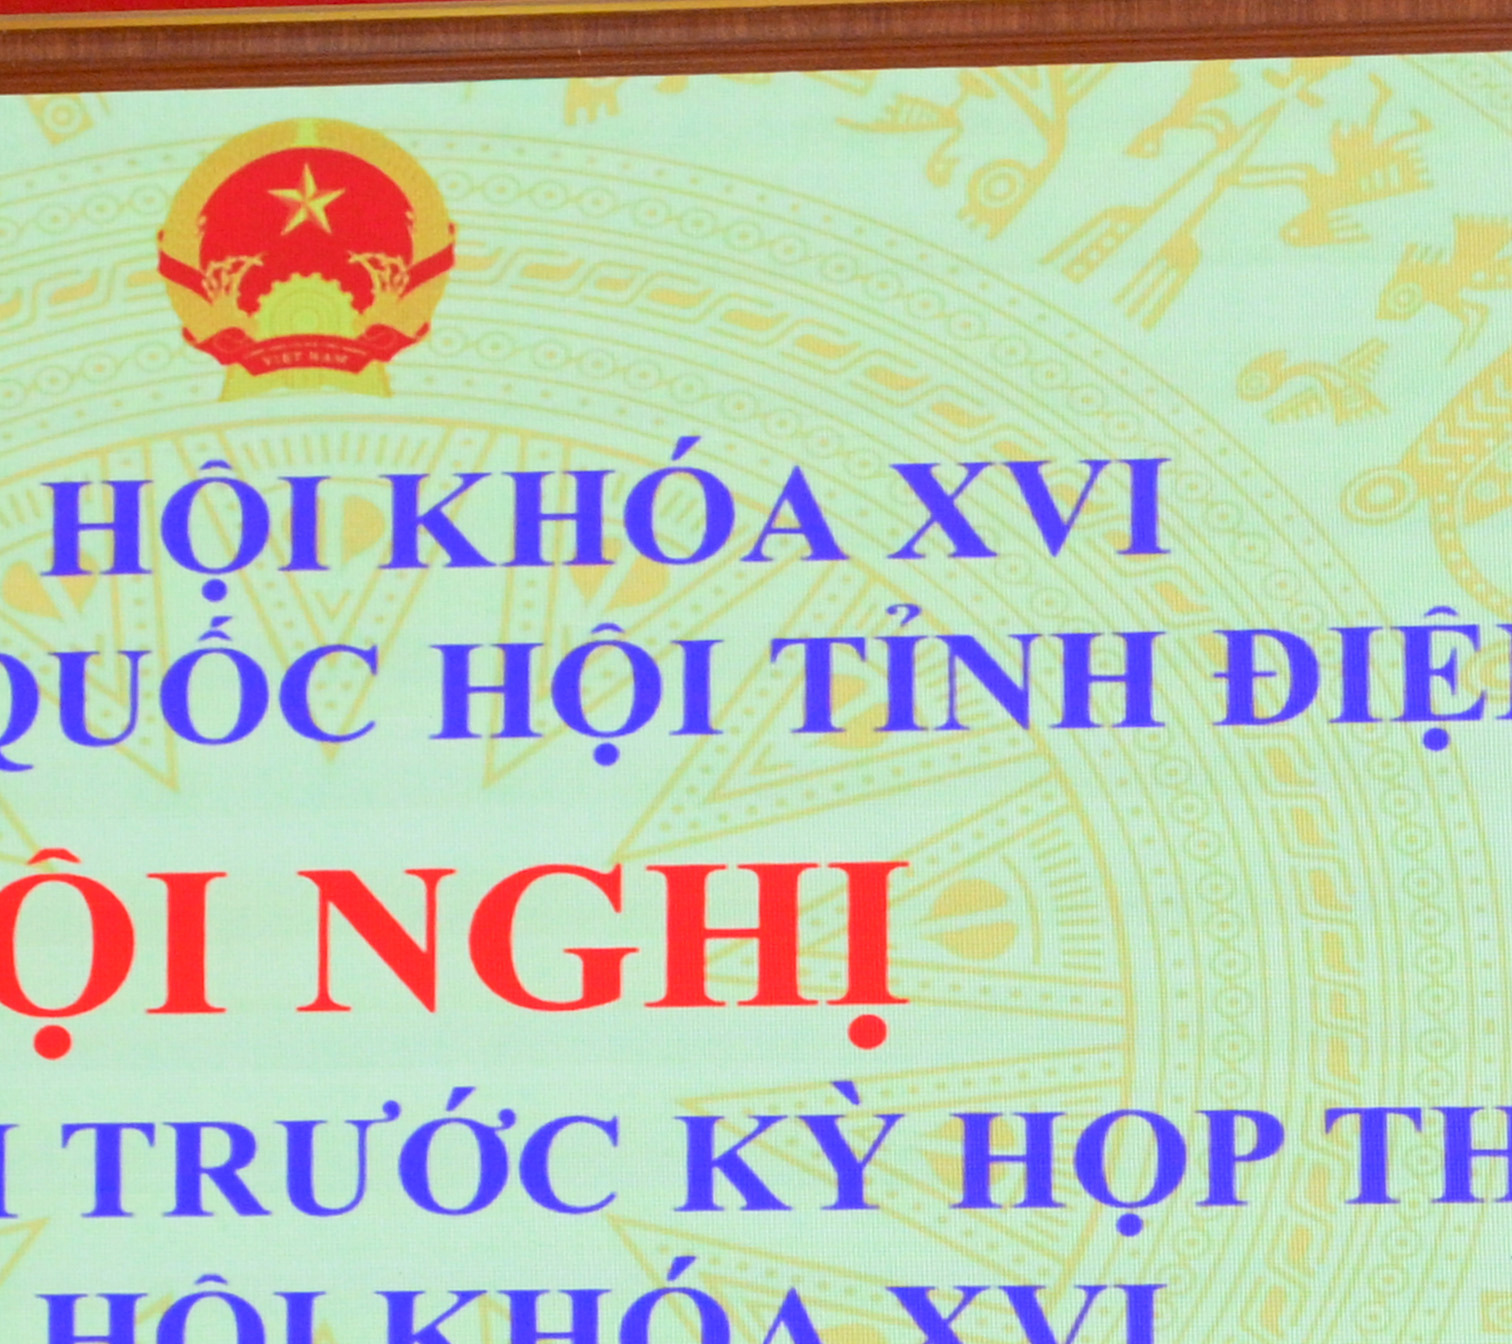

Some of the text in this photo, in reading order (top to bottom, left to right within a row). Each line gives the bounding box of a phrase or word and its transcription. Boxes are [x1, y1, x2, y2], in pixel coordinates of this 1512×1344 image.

[42, 458, 330, 604] HỘI
[381, 434, 849, 571] KHÓA
[887, 457, 1170, 561] XVI
[430, 621, 724, 768] HỘI
[769, 603, 1166, 735] TỈNH
[296, 860, 911, 1051] NGHỊ
[60, 1085, 621, 1219] TRƯỚC
[675, 1079, 905, 1214] KỲ
[952, 1107, 1286, 1239] HỌP
